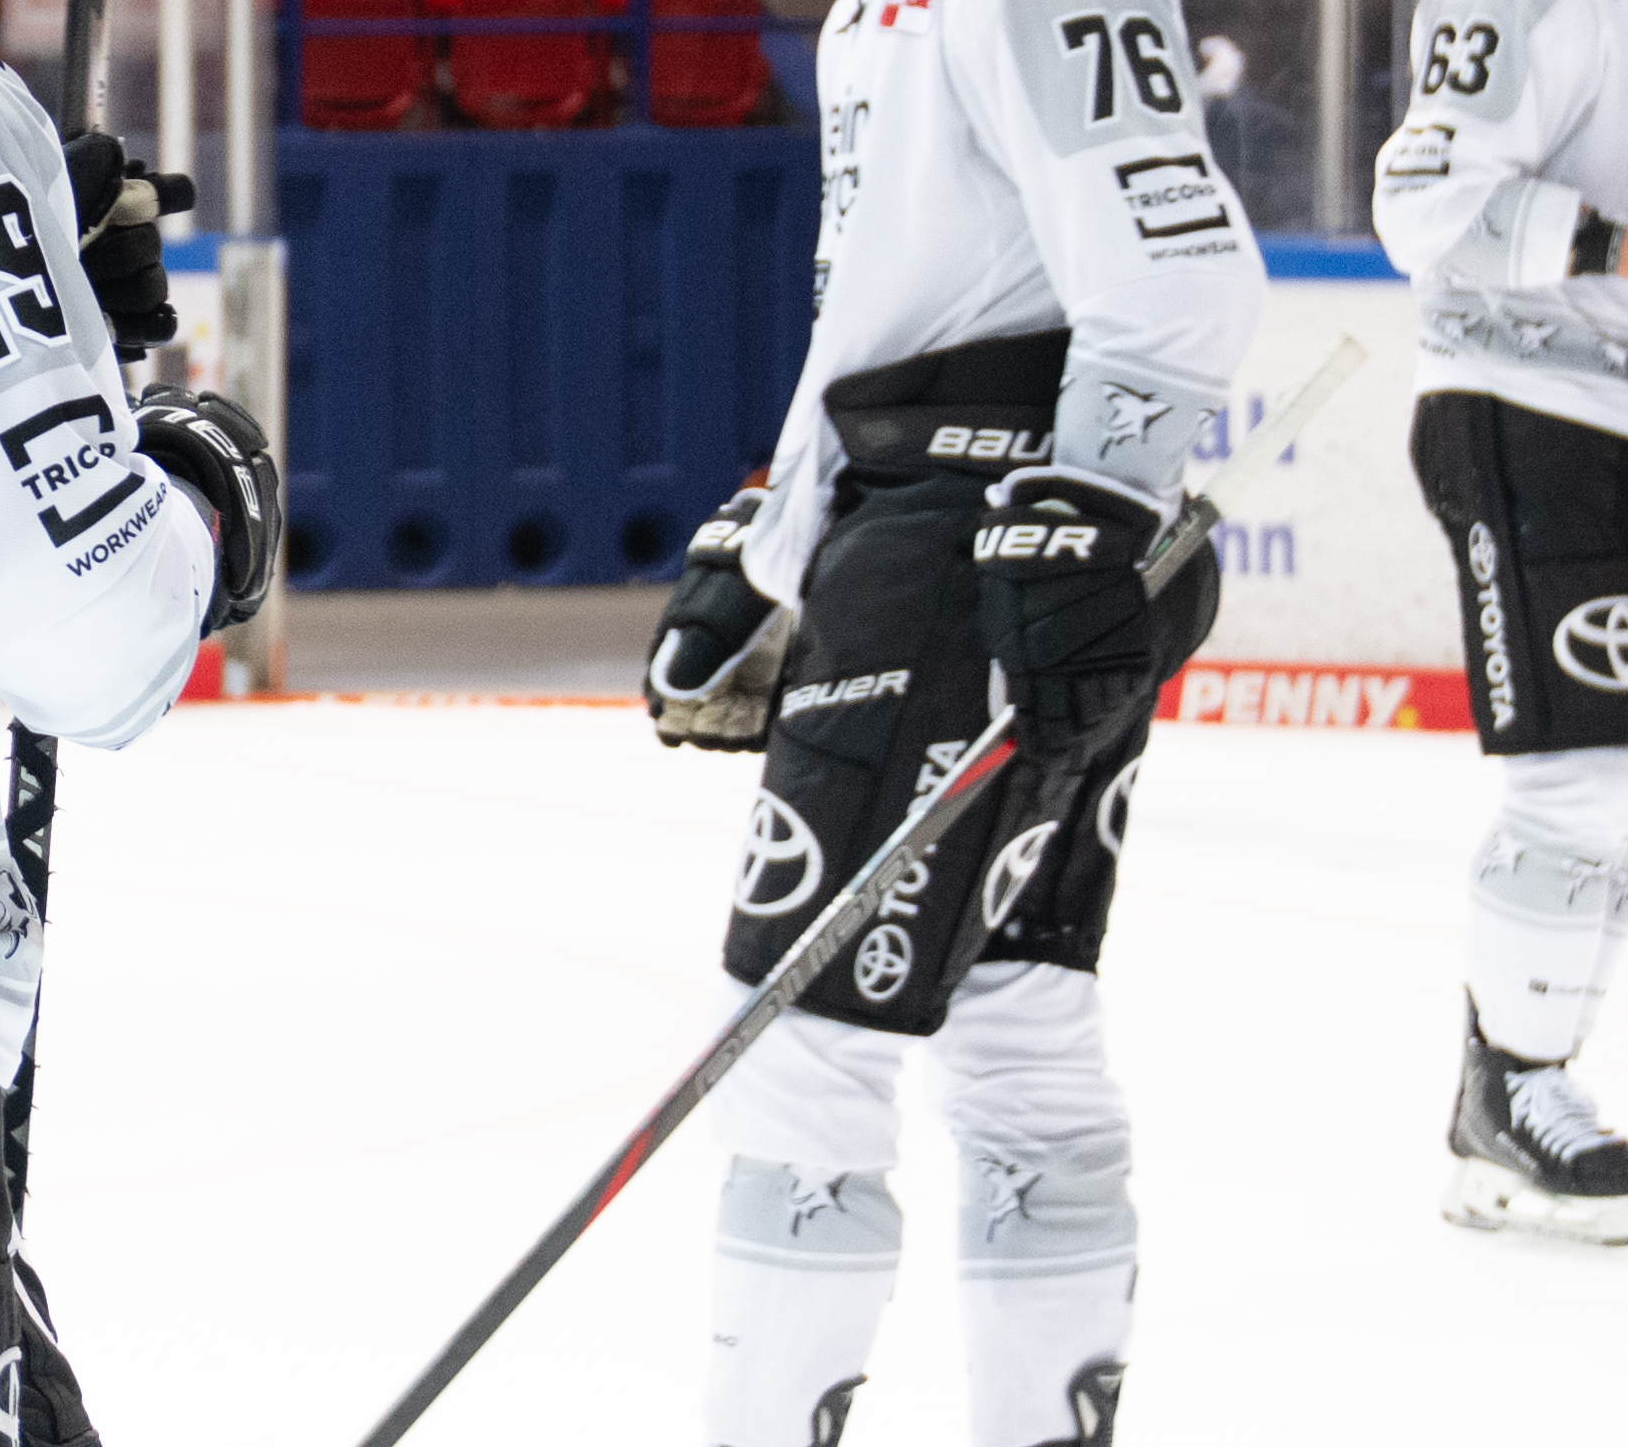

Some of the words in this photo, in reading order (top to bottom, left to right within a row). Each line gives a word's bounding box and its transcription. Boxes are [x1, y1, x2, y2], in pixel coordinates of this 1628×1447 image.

[1058, 11, 1186, 125] 76
[1420, 21, 1501, 97] 63
[65, 481, 168, 578] WORKWEAR
[1477, 581, 1517, 733] TOYOTA
